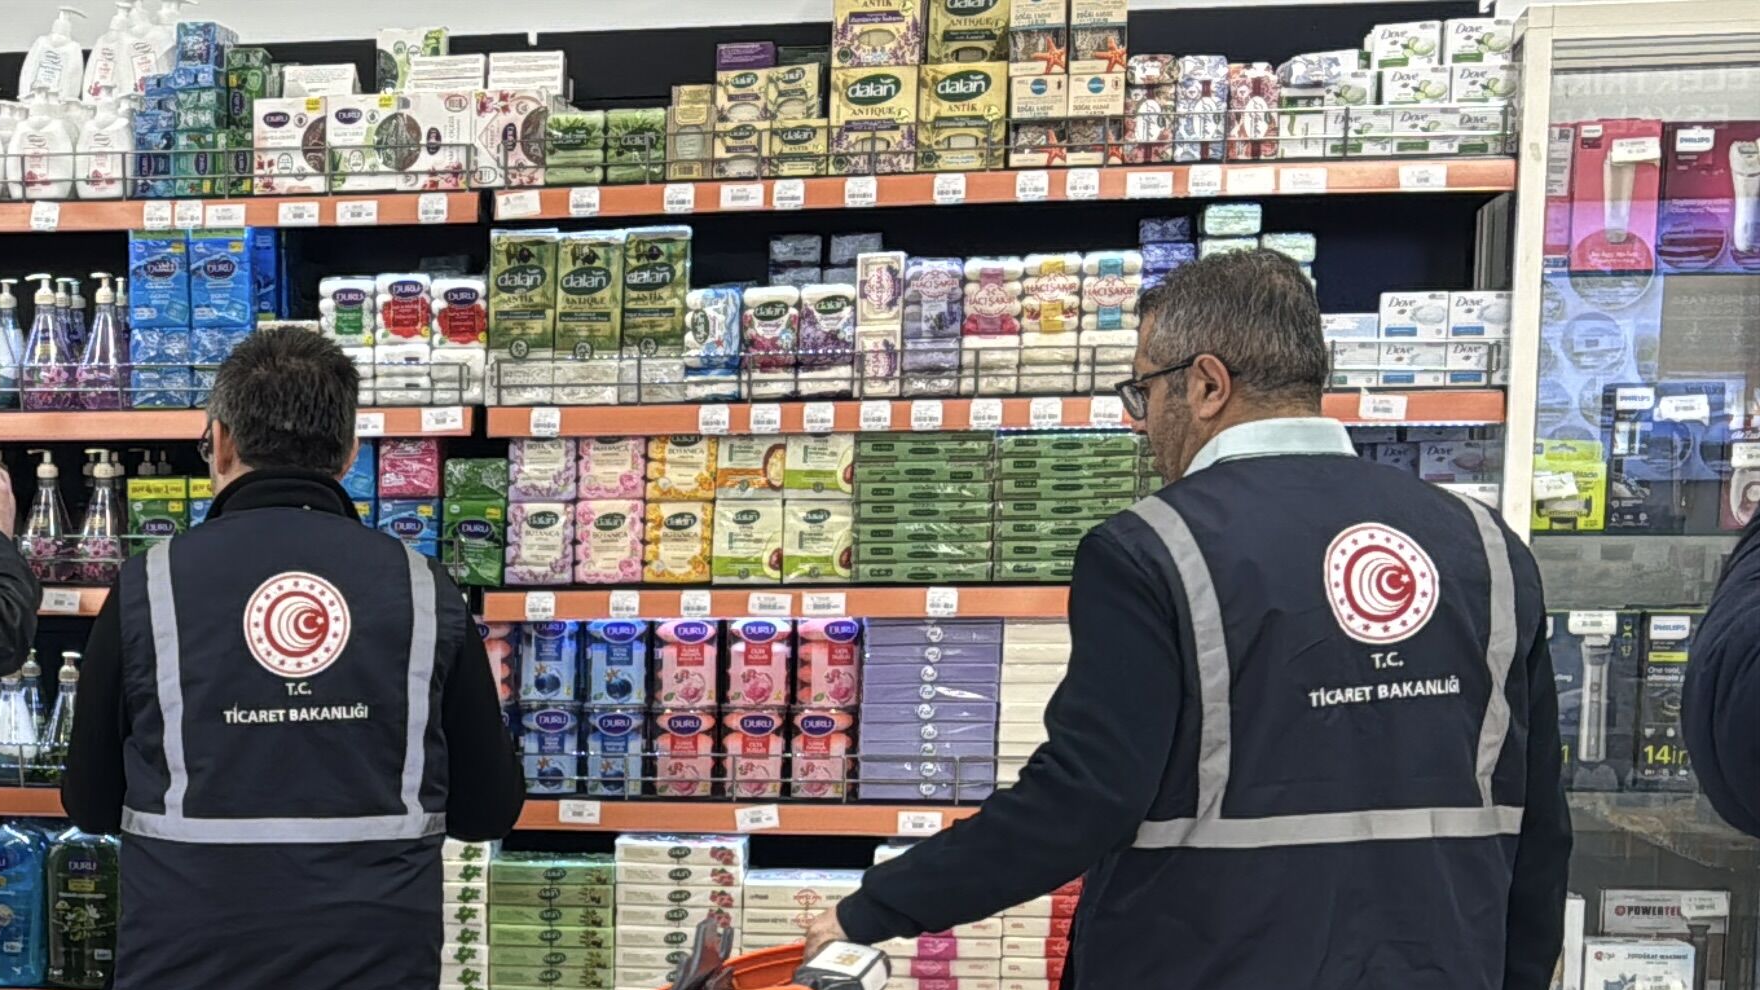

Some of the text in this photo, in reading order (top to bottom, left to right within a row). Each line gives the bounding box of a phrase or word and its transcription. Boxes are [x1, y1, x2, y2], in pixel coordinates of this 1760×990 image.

[1381, 28, 1408, 39] Dove
[1455, 23, 1482, 34] Dove
[1391, 71, 1419, 82] Dove
[1460, 69, 1487, 79] Dove
[847, 78, 896, 99] dalan
[936, 74, 986, 95] dalan
[1400, 111, 1429, 122] Dove
[1679, 136, 1711, 144] PHILIPS
[497, 269, 542, 288] dalan
[563, 270, 607, 288] dalan
[1388, 296, 1417, 307] Dove
[1455, 296, 1483, 307] Dove
[394, 521, 423, 533] DURU
[460, 523, 490, 534] DURU
[606, 624, 637, 637] DURU
[677, 624, 708, 637] DURU
[745, 624, 775, 636] DURU
[828, 624, 858, 636] DURU
[1653, 623, 1687, 631] PHILIPS
[1370, 652, 1404, 669] T.C.
[285, 682, 312, 696] T.C.
[1308, 675, 1460, 707] TİCARET BAKANLIĞI
[223, 702, 369, 724] TİCARET BAKANLIĞI
[538, 715, 567, 726] DURU
[603, 717, 631, 729] DURU
[670, 717, 700, 729] DURU
[743, 718, 773, 730] DURU
[804, 718, 834, 730] DURU
[68, 860, 97, 871] DURU
